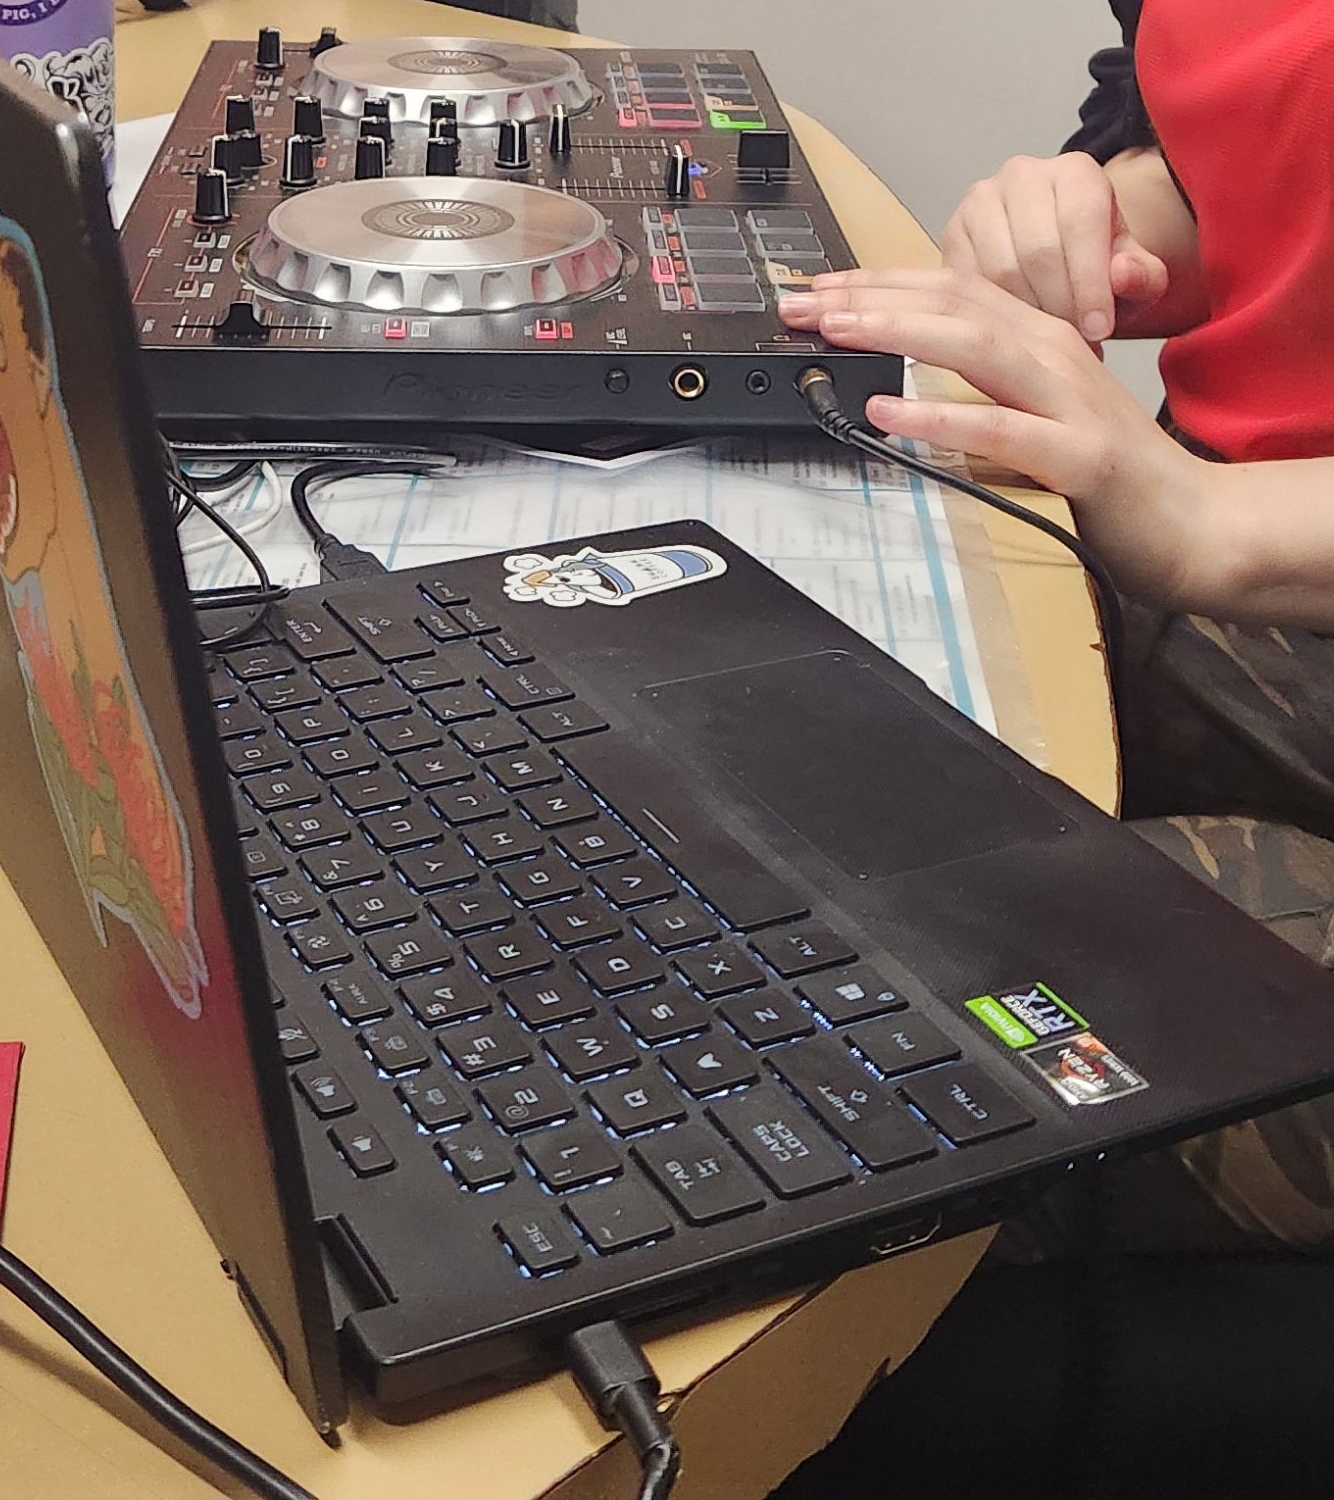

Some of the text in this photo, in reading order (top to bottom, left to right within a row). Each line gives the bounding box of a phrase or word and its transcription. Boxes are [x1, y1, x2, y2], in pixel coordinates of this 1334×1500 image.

[38, 2, 48, 13] I
[286, 618, 315, 644] ENTER
[516, 674, 540, 695] CTRL
[302, 717, 321, 729] P
[551, 711, 574, 728] ALT
[398, 727, 415, 739] L
[425, 760, 445, 773] K
[510, 760, 534, 775] M
[457, 795, 478, 808] J
[547, 797, 568, 812] N
[390, 820, 412, 833] U
[492, 831, 514, 846] H
[584, 835, 606, 849] B
[331, 857, 350, 870] 7
[423, 860, 445, 874] Y
[528, 871, 550, 885] G
[621, 875, 643, 889] V
[459, 902, 482, 915] T
[567, 915, 591, 929] F
[664, 917, 687, 931] C
[397, 940, 422, 956] 5
[499, 943, 522, 960] R
[787, 934, 818, 957] ALT
[607, 956, 631, 973] D
[707, 959, 731, 976] X
[434, 986, 456, 1001] 4
[537, 989, 560, 1005] E
[650, 1003, 674, 1021] S
[753, 1006, 779, 1023] Z
[980, 1001, 1012, 1032] NVIDIA
[999, 994, 1050, 1036] GEFORCE
[1014, 988, 1076, 1033] RTX
[576, 1036, 605, 1058] W
[891, 1030, 915, 1052] FN
[696, 1052, 723, 1071] A
[1057, 1048, 1111, 1090] RYZEN
[514, 1087, 539, 1105] 2
[623, 1088, 649, 1110] Q
[817, 1084, 861, 1124] SHIFT
[948, 1083, 990, 1122] CTRL
[752, 1123, 793, 1164] CAPS
[769, 1120, 810, 1159] LOCK
[665, 1161, 697, 1191] TAB
[521, 1223, 555, 1253] ESC
